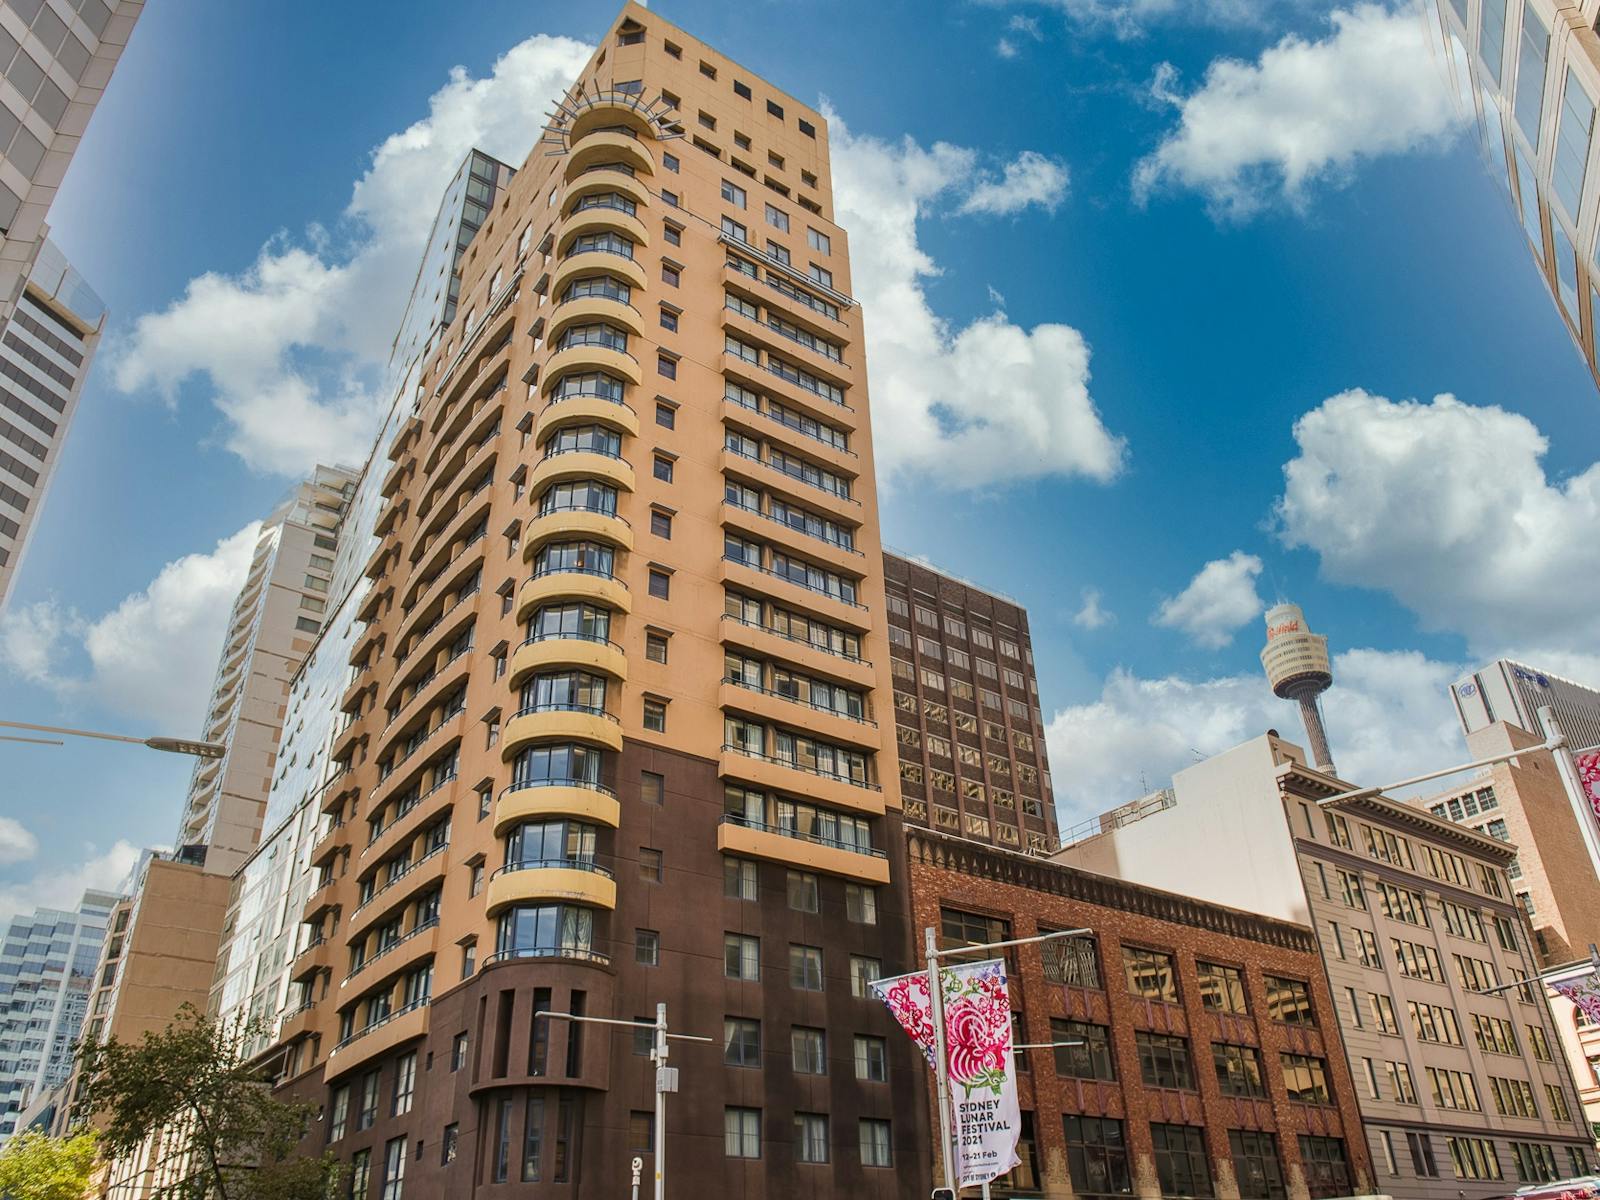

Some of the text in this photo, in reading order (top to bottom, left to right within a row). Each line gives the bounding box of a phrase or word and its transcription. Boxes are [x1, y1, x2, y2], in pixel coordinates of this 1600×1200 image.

[960, 1112, 994, 1123] LUNAR
[961, 1120, 1011, 1135] FESTIVAL
[962, 1135, 983, 1146] 2021
[982, 1150, 998, 1159] Feb
